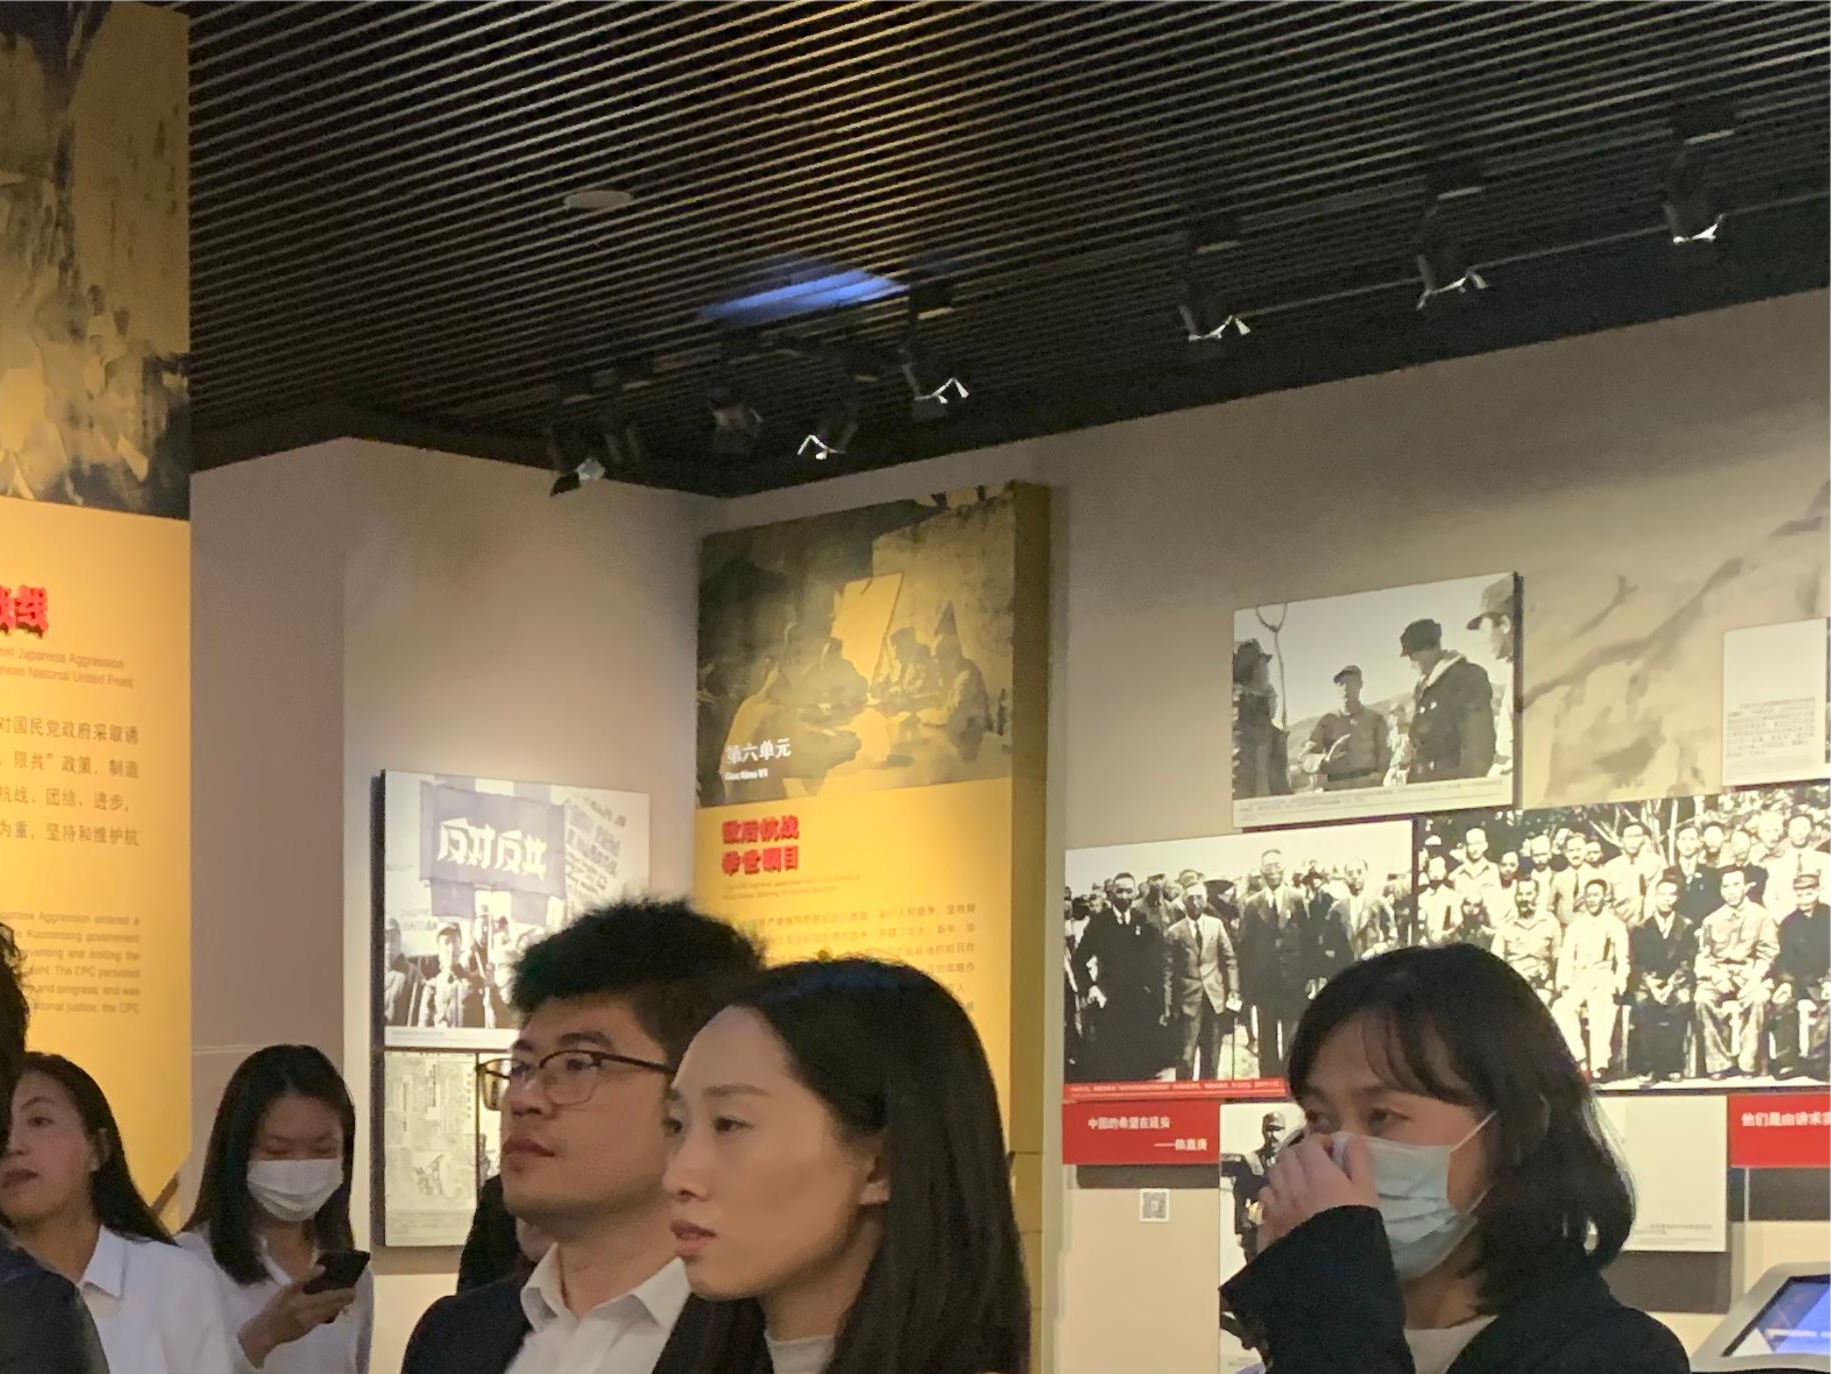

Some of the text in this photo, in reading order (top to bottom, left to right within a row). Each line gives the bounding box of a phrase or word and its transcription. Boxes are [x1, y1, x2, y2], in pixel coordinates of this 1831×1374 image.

[69, 652, 124, 669] Aggression
[727, 737, 791, 767] 第六单元
